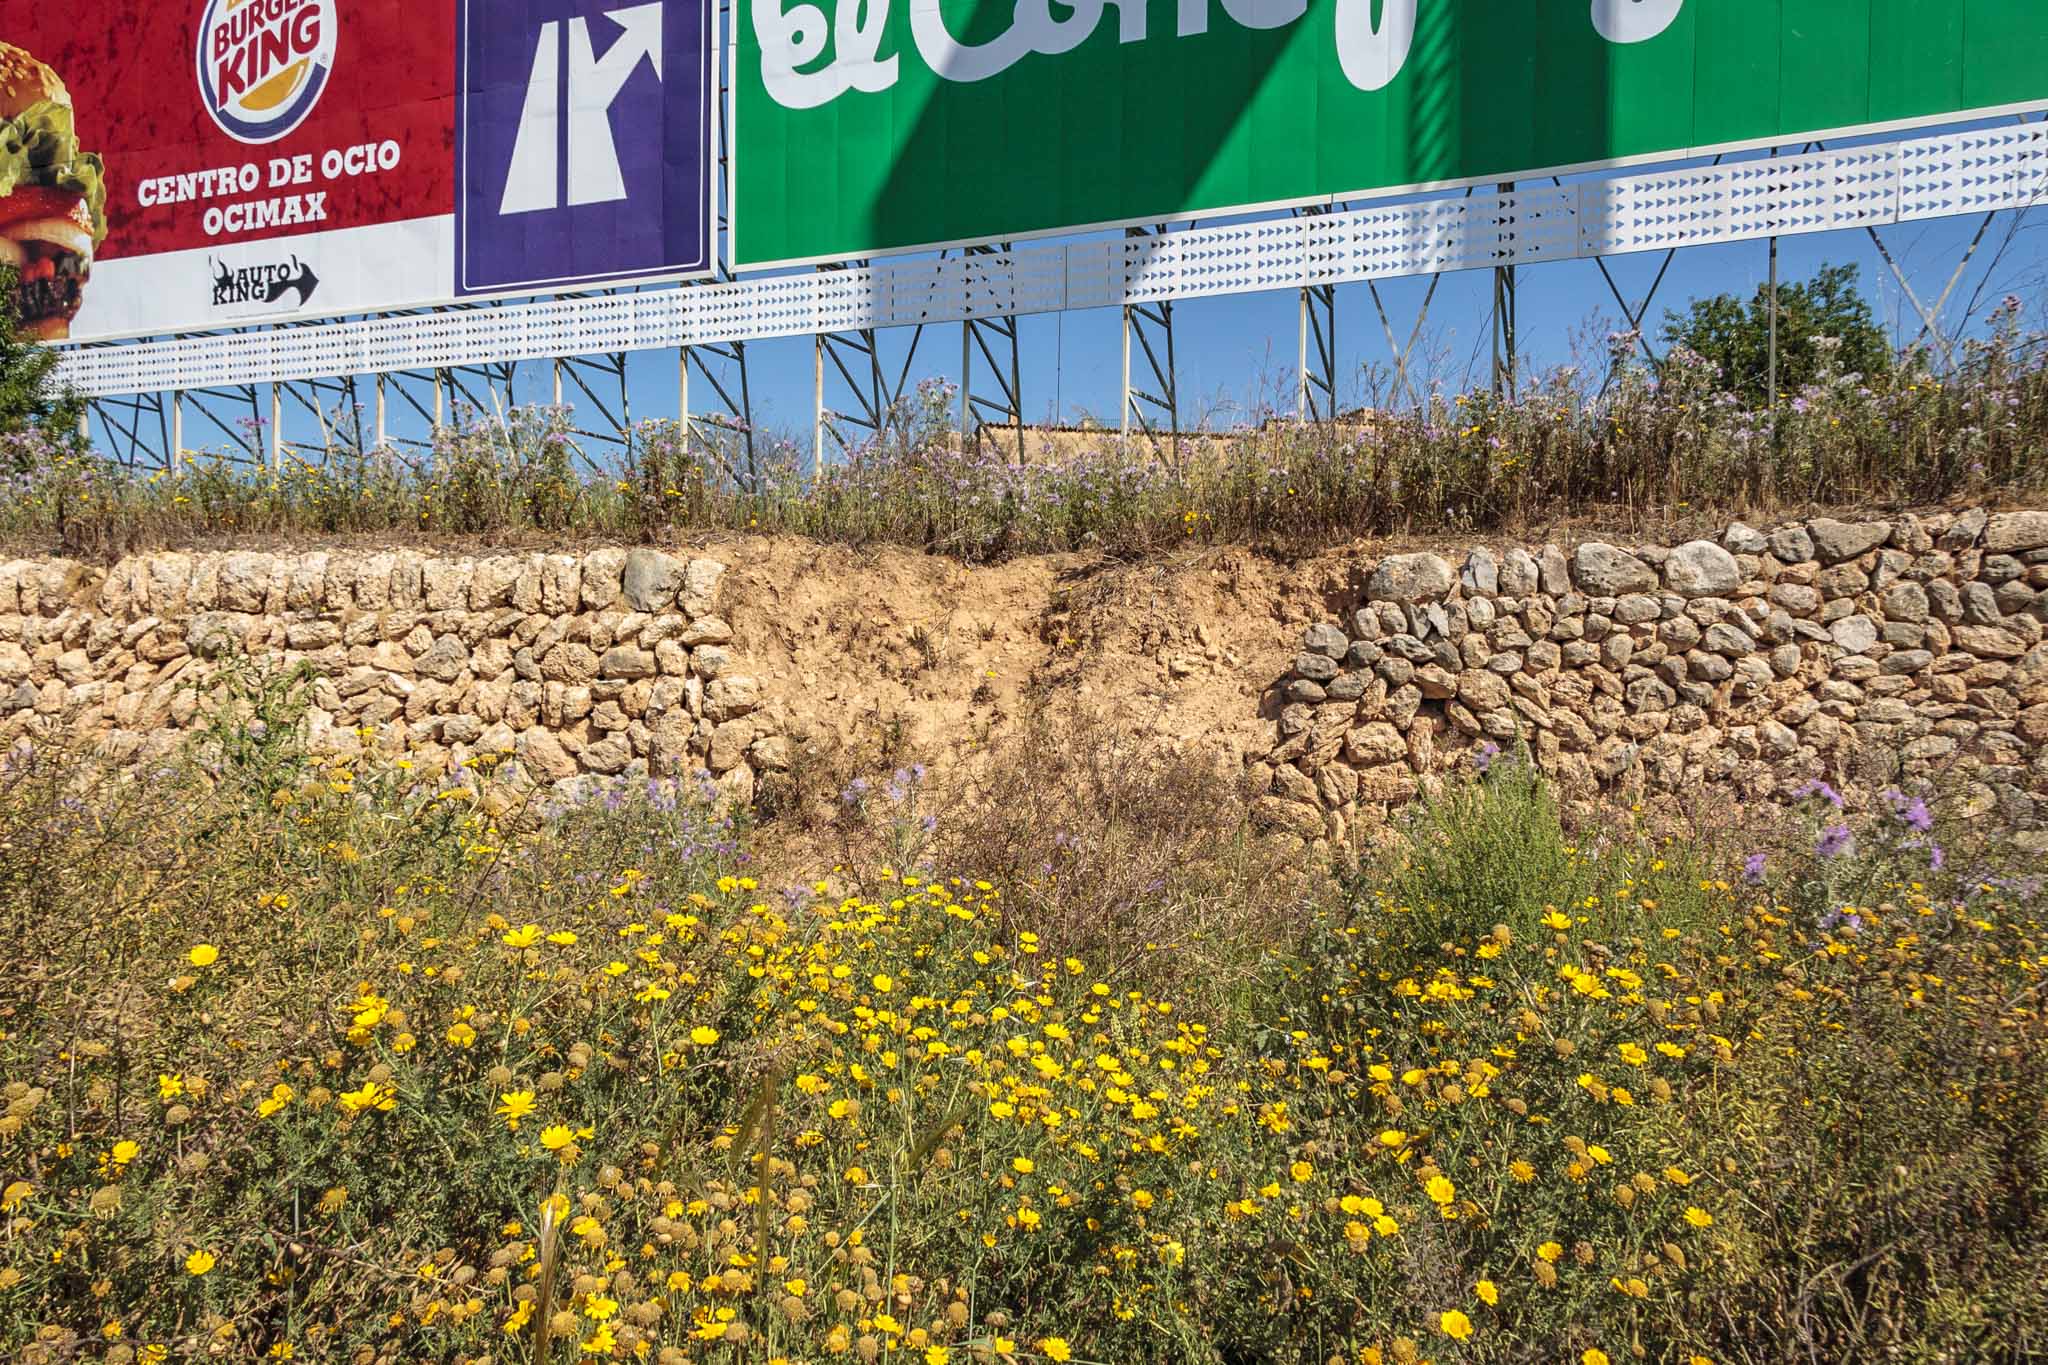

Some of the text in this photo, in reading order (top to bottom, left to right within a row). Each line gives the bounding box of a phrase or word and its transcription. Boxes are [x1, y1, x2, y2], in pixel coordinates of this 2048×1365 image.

[214, 0, 305, 62] BURG
[218, 4, 321, 108] KING
[137, 139, 401, 208] CENTRO DE OCIO
[203, 191, 327, 236] OCIMAX
[212, 282, 265, 306] KING
[235, 263, 291, 288] AUTO
